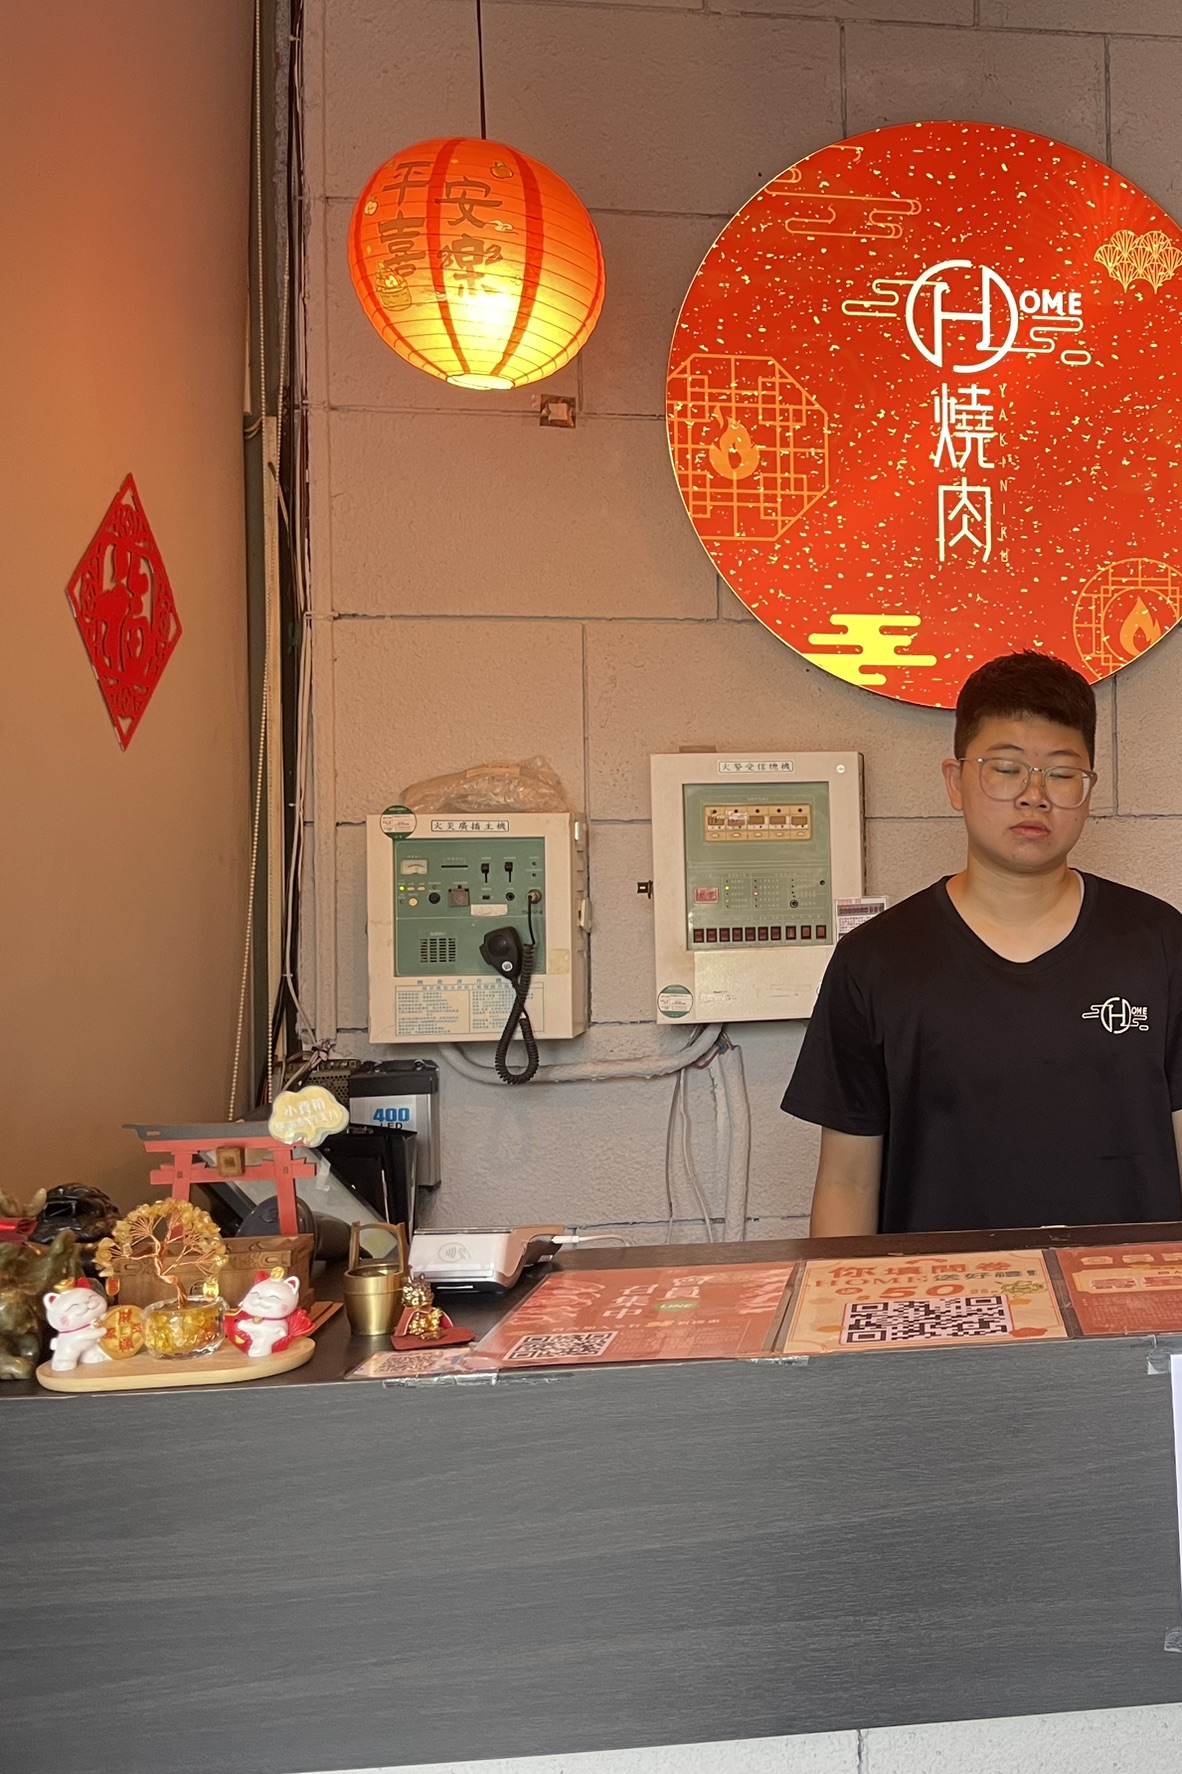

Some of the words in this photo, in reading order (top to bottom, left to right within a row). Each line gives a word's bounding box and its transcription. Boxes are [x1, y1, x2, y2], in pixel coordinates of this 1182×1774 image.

[382, 160, 503, 228] 平安
[906, 260, 1082, 373] HOME
[933, 382, 998, 563] 燒肉
[1101, 997, 1147, 1034] HOME
[373, 1108, 410, 1122] 400
[829, 1262, 1011, 1279] 你填問卷
[879, 1284, 966, 1299] 50
